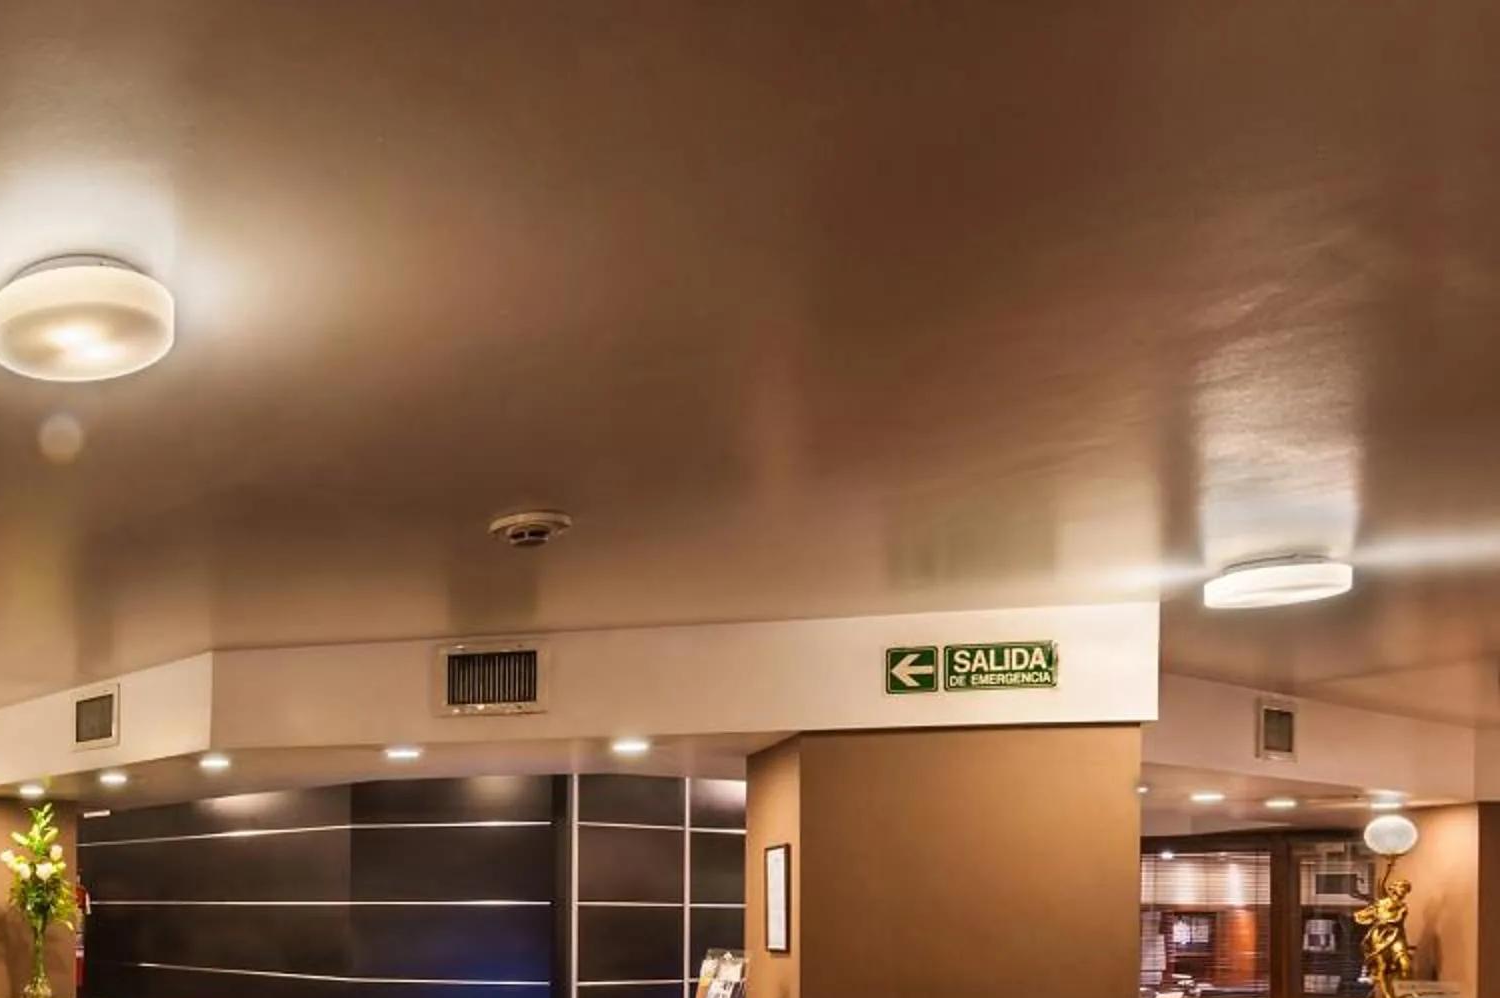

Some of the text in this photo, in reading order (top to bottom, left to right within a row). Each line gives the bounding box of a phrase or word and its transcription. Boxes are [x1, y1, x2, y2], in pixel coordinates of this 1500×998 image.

[953, 647, 1047, 672] SALIDA
[950, 671, 1051, 687] DE EMERGENCIA
